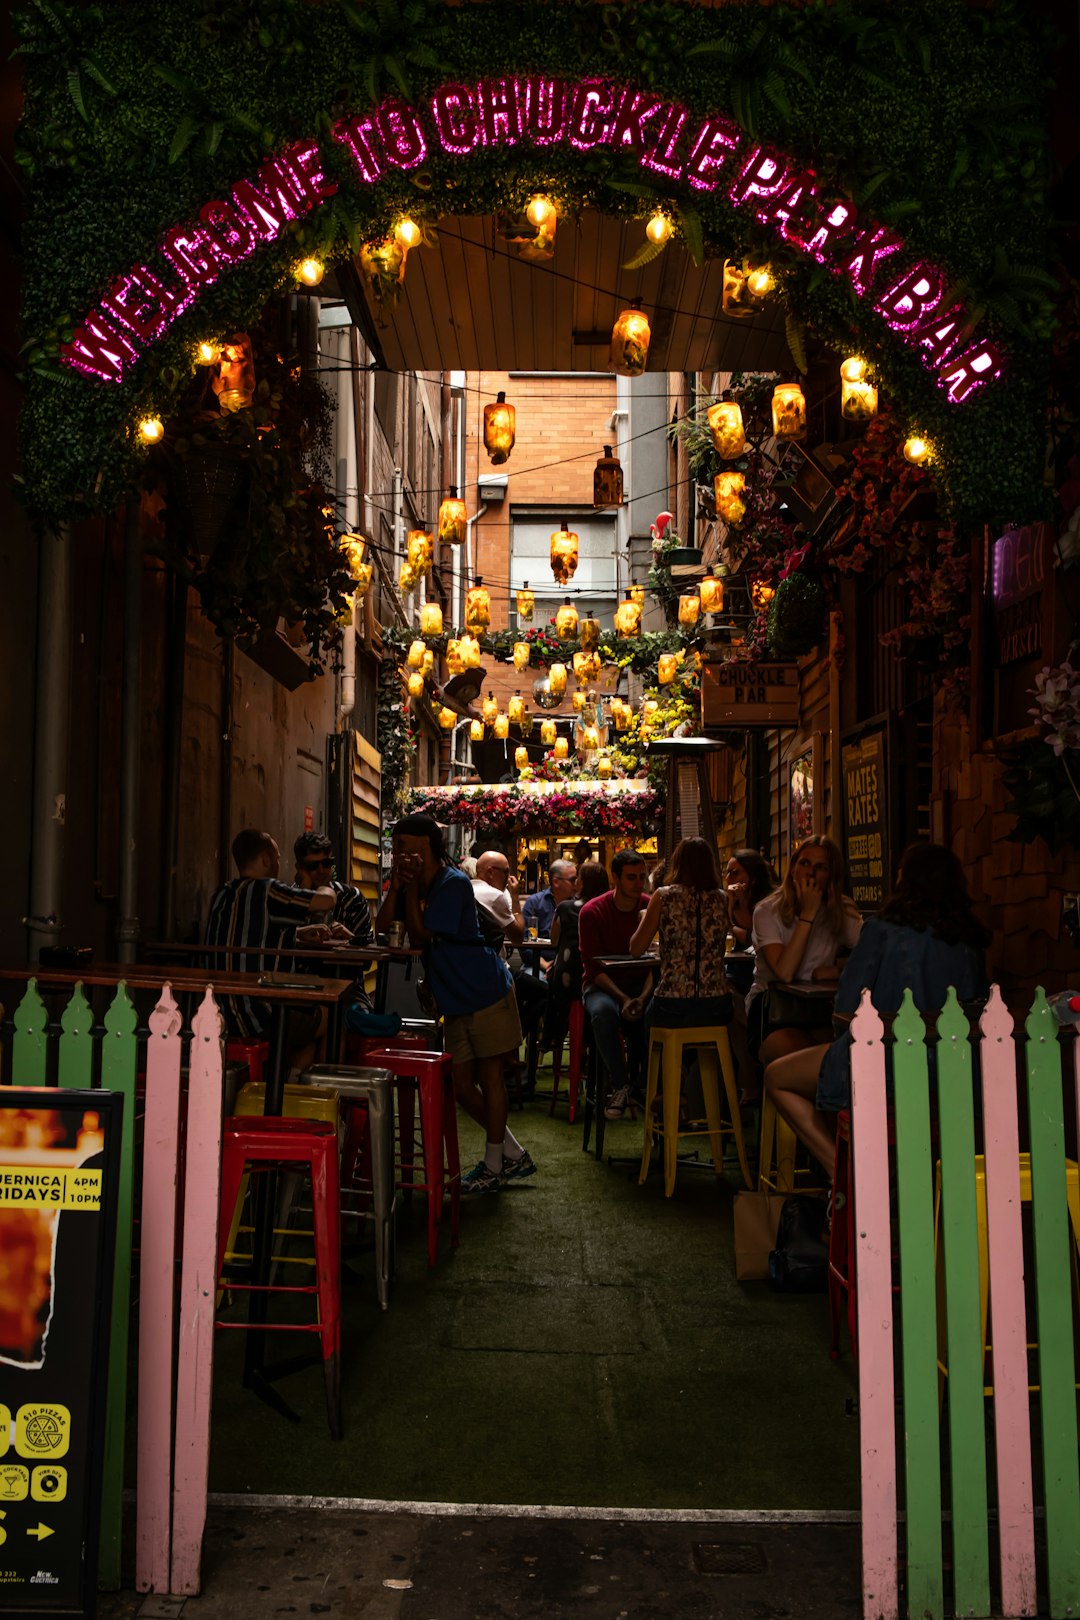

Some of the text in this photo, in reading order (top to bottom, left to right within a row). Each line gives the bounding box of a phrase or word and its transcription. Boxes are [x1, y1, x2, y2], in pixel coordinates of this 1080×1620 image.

[59, 76, 1003, 403] WELCOME TO CHUCKLE PARK BAR
[720, 669, 785, 685] CHUCKLE
[847, 763, 878, 798] MATES
[847, 792, 879, 826] RATES
[0, 1174, 61, 1186] ERNICA
[74, 1178, 99, 1187] 4PM
[70, 1194, 101, 1204] 10PM
[23, 1408, 66, 1427] $10 PIZZAS
